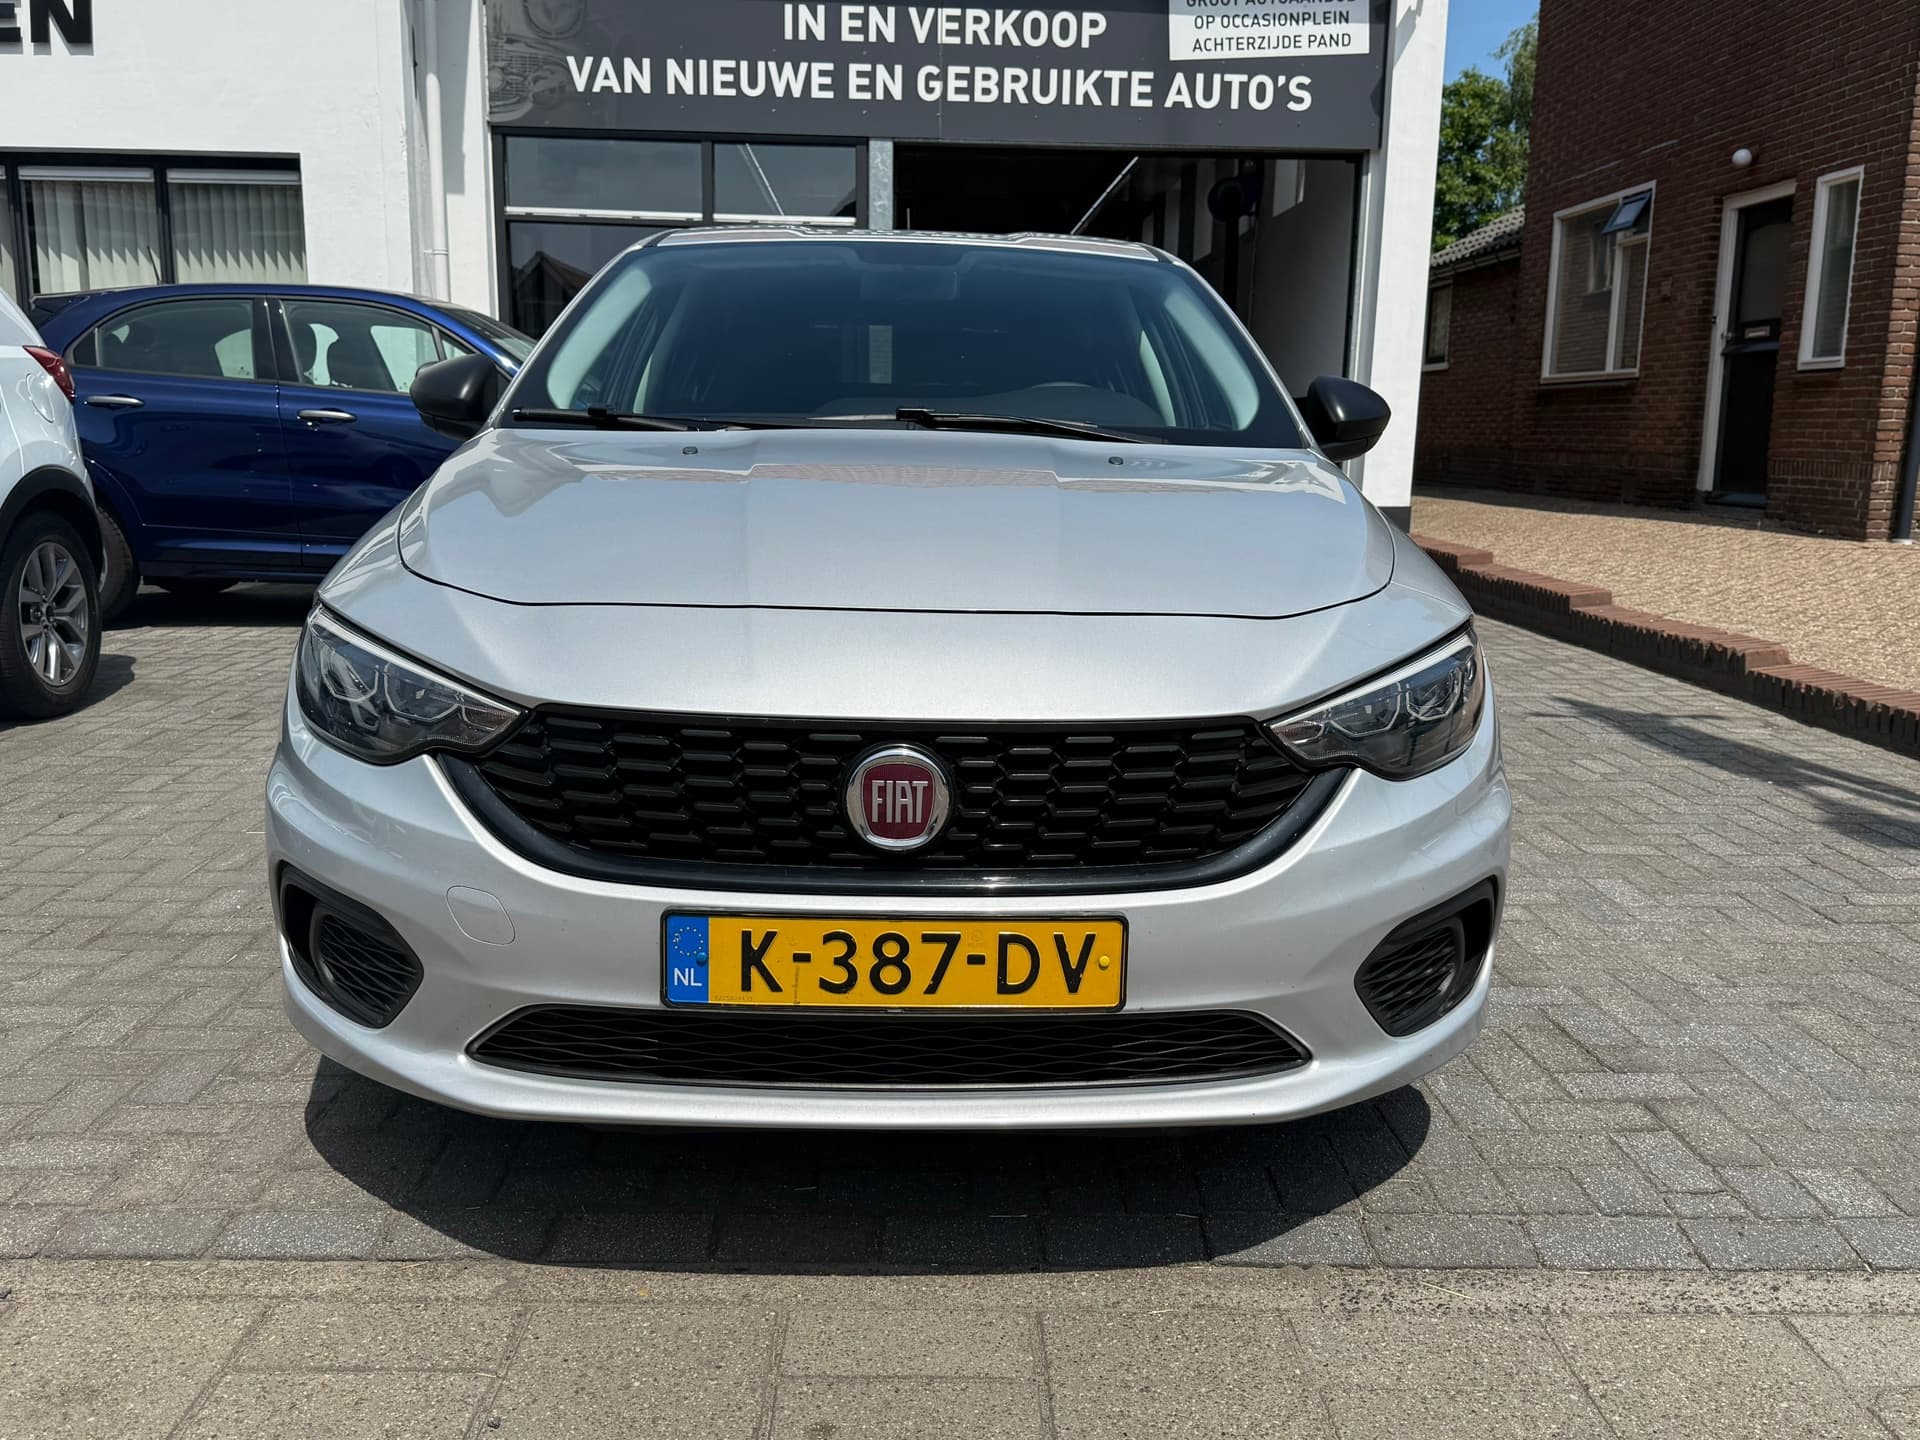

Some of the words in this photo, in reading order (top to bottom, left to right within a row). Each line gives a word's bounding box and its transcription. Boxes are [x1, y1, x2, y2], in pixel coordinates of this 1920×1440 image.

[0, 0, 93, 50] N
[783, 4, 826, 41] IN
[840, 5, 896, 43] EN
[908, 7, 1107, 49] VERKOOP
[1194, 15, 1215, 30] OP
[1220, 10, 1350, 29] OCCASIONPLEIN
[1192, 34, 1302, 53] ACHTERZIJDE
[1308, 33, 1351, 49] PAND
[566, 55, 652, 94] VAN
[666, 58, 834, 99] NIEUWE
[848, 63, 902, 100] EN
[917, 65, 1154, 108] GEBRUIKTE
[1163, 72, 1312, 112] AUTO'S
[870, 779, 929, 823] FIAT
[674, 967, 703, 986] NL
[740, 929, 1096, 995] K-387-DV
